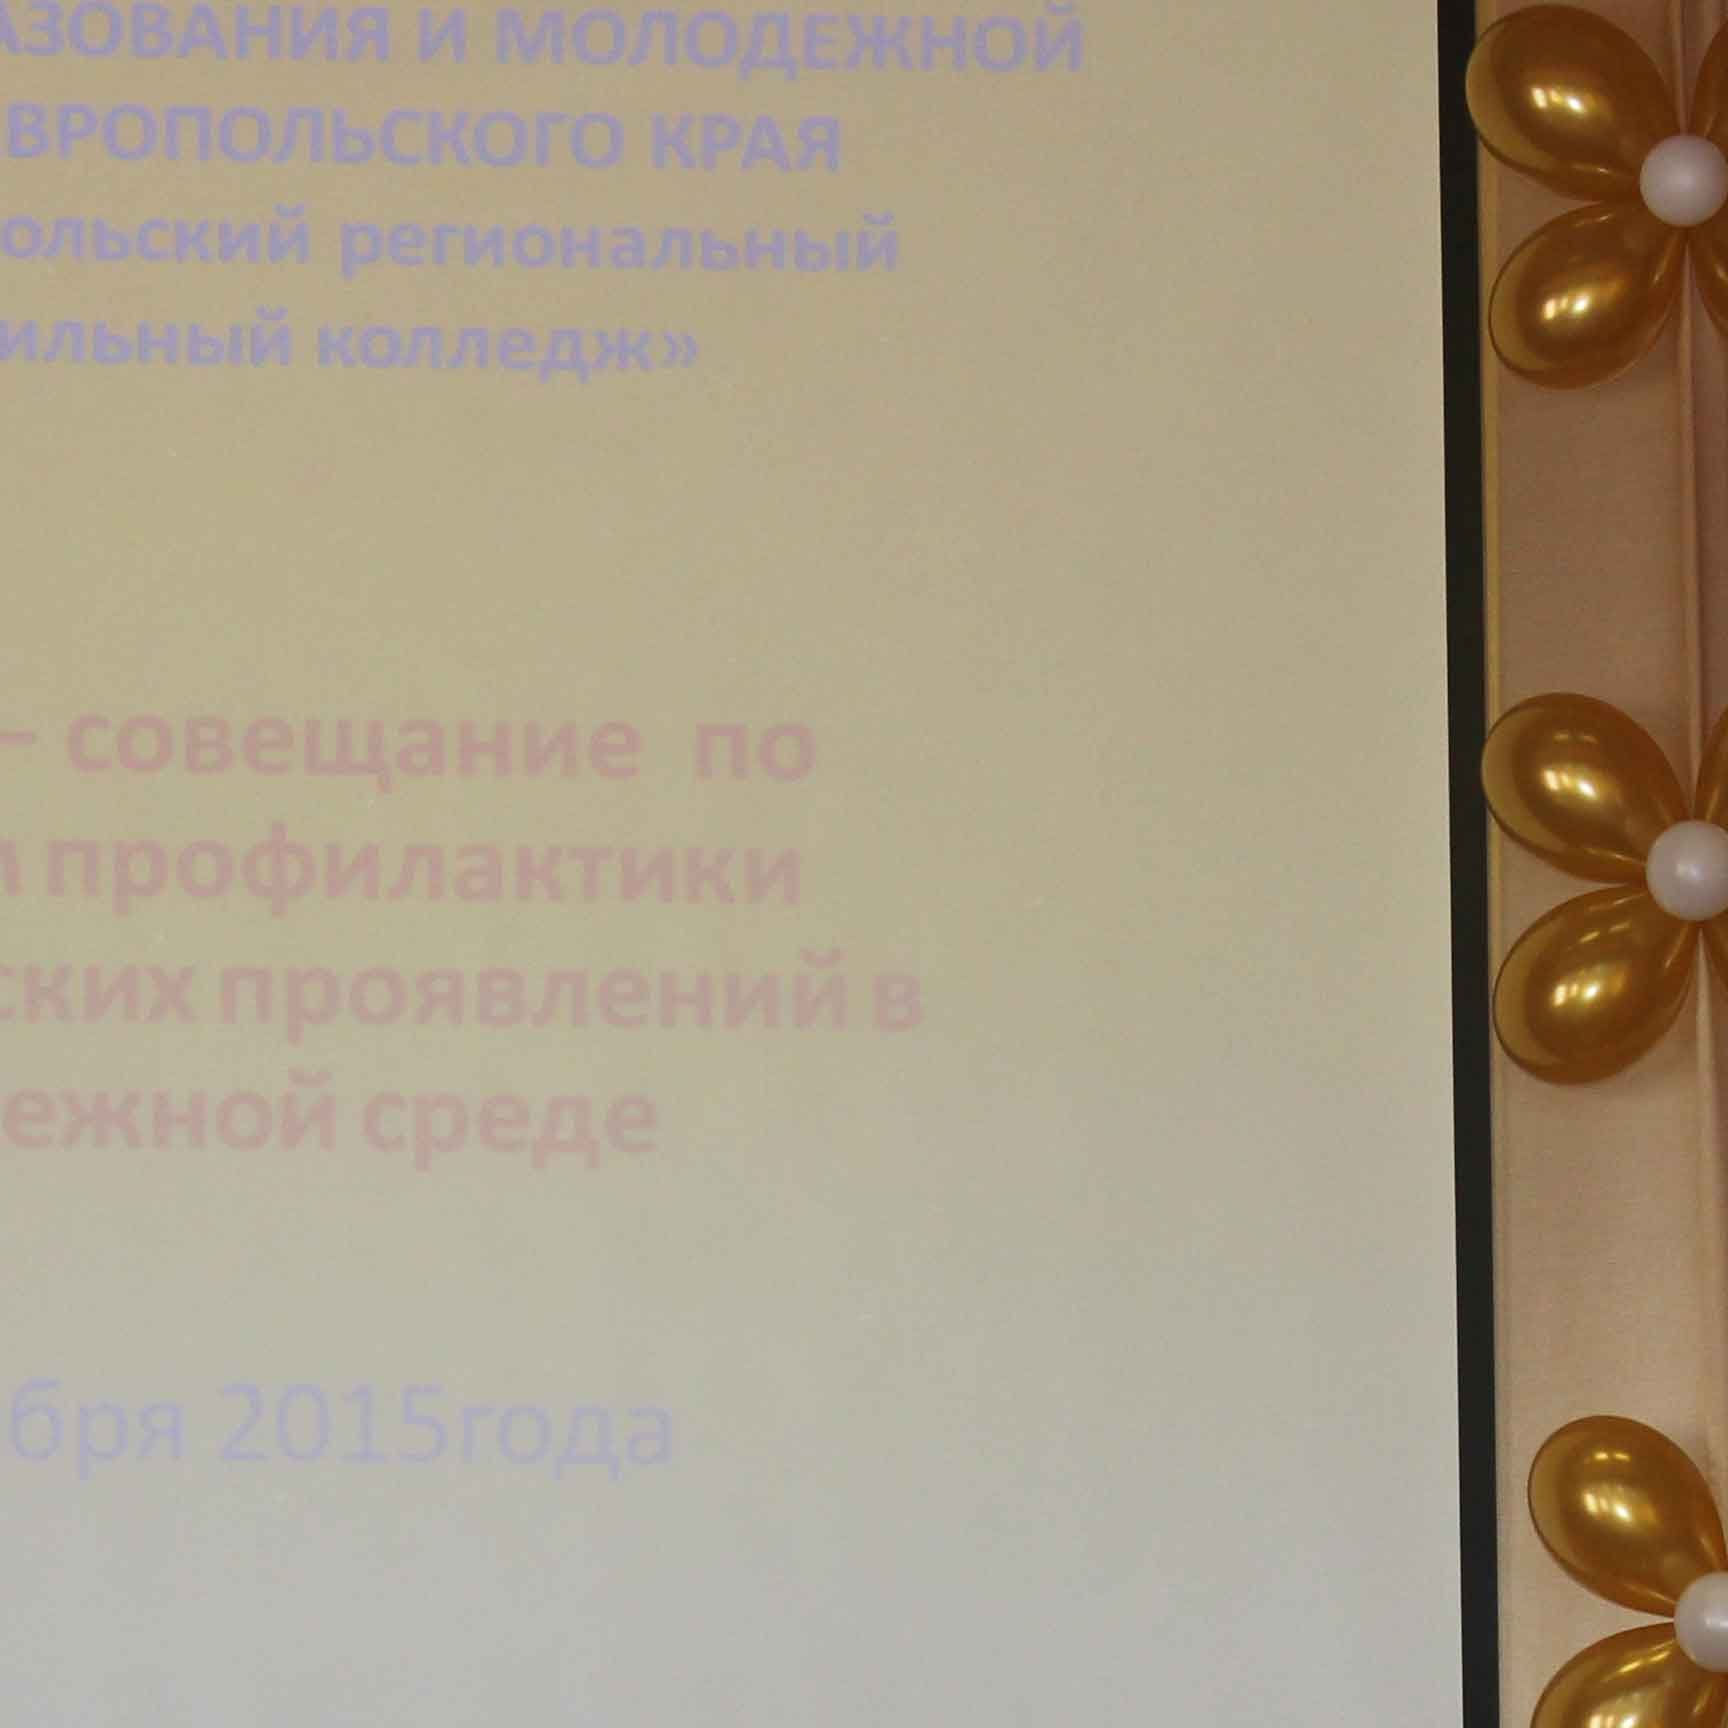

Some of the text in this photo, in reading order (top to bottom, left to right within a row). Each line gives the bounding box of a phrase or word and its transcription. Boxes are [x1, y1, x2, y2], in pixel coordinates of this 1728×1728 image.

[418, 8, 467, 61] И
[496, 0, 1084, 80] МОЛОДЕЖНОЙ
[652, 113, 842, 172] КРАЯ
[340, 212, 899, 279] региональный
[317, 324, 700, 383] колледж»
[66, 713, 644, 794] совещание
[695, 722, 816, 782] по
[47, 822, 801, 917] профилактики
[219, 949, 849, 1046] проявлений
[874, 973, 923, 1034] в
[360, 1092, 658, 1173] среде
